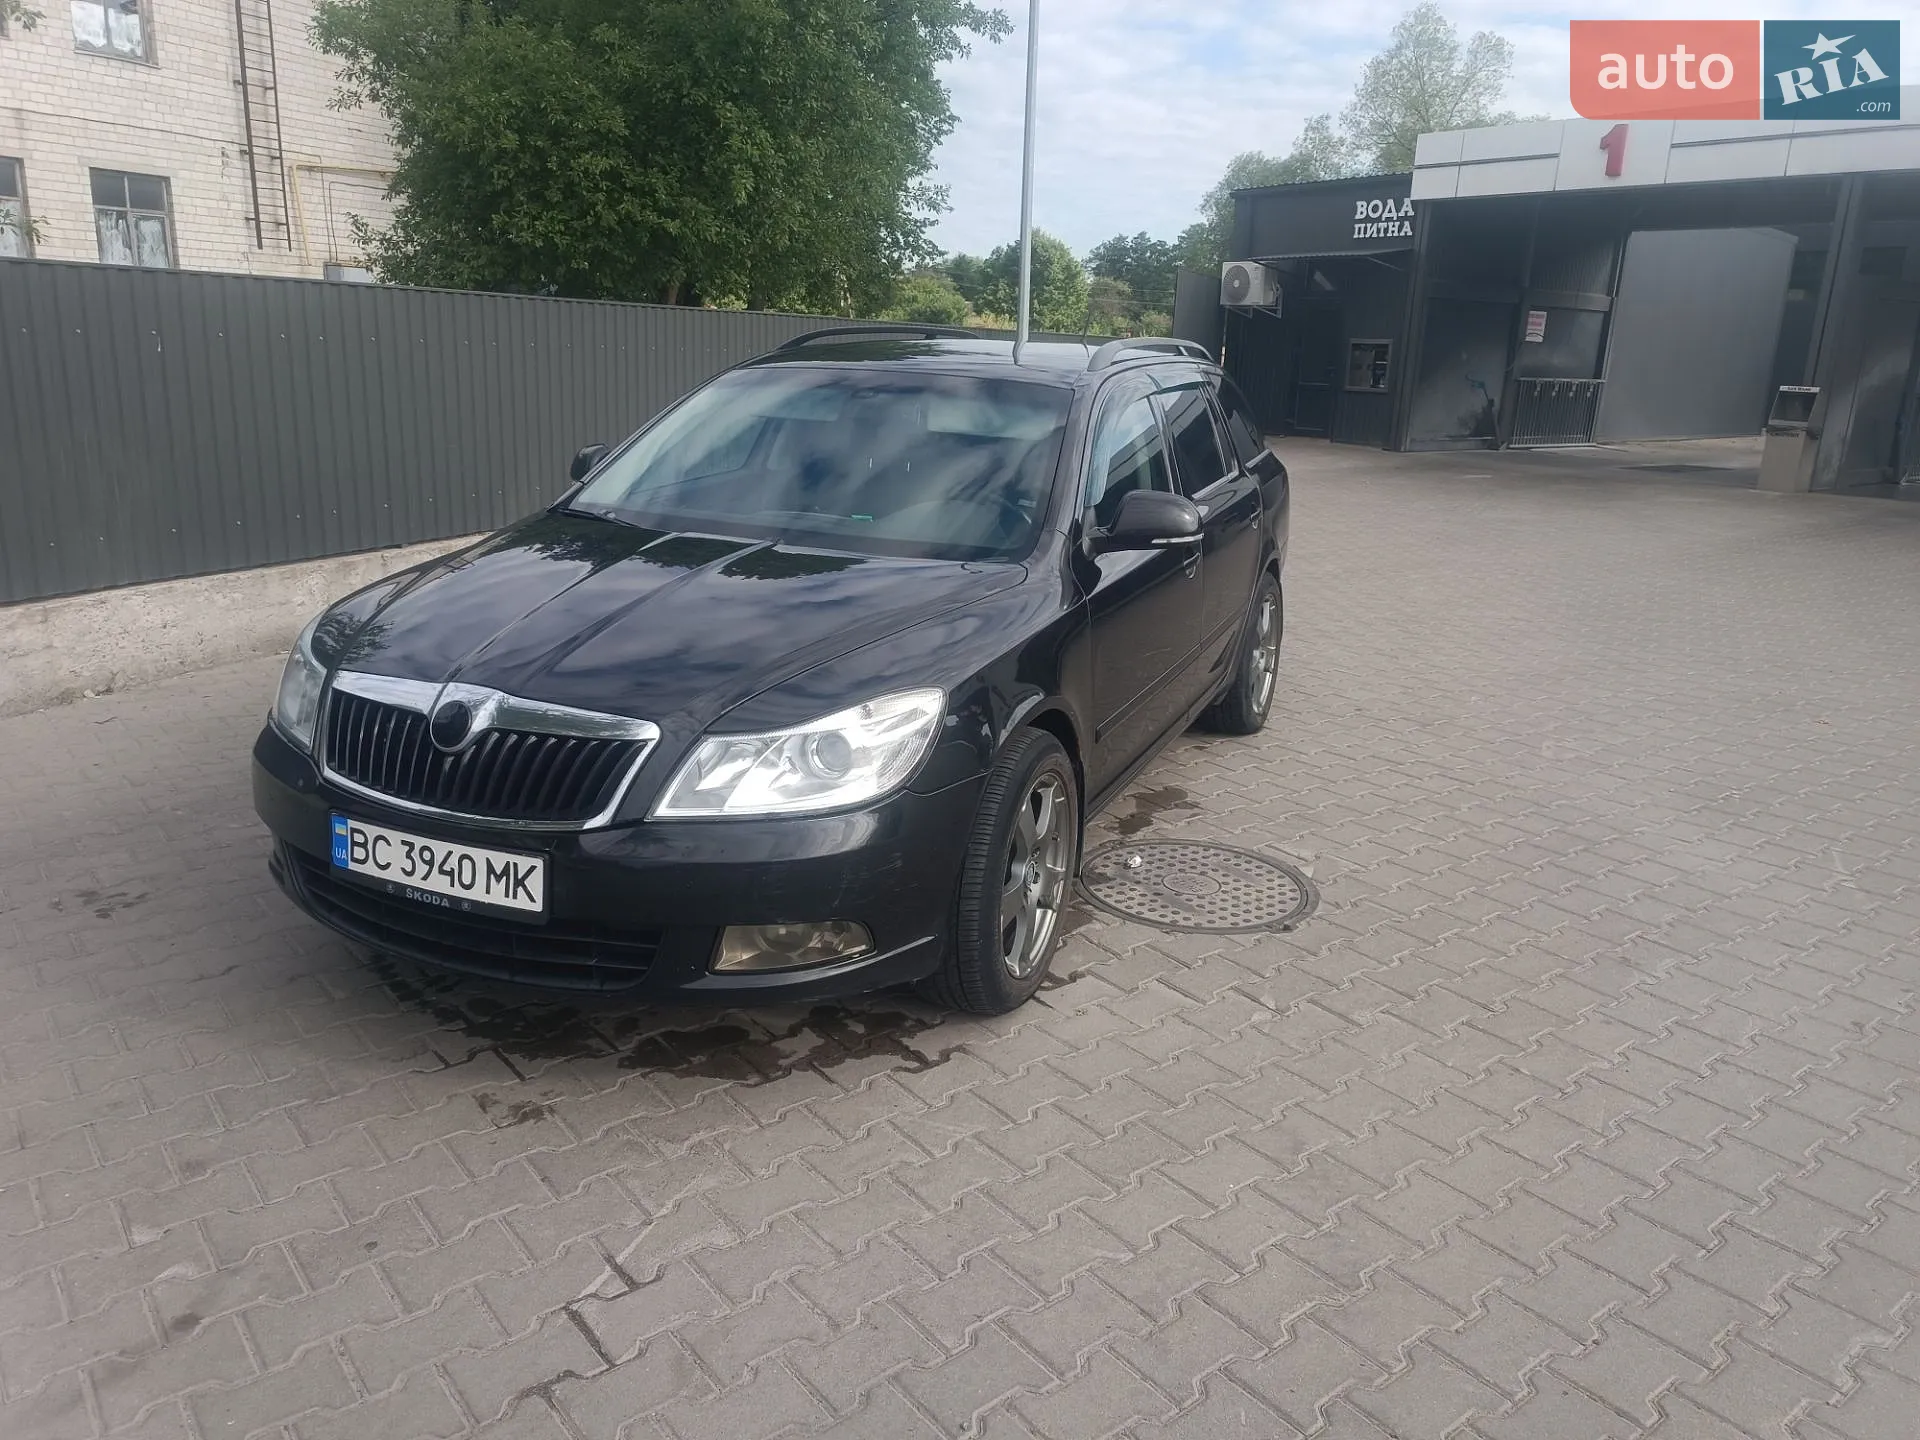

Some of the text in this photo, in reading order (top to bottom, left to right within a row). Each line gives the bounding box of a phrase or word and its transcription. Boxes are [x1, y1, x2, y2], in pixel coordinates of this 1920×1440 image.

[1600, 123, 1629, 177] 1
[1354, 197, 1415, 221] ВОДА
[1353, 221, 1413, 238] ПИТНА
[335, 847, 348, 860] UA
[350, 828, 537, 904] BC 3940 MK
